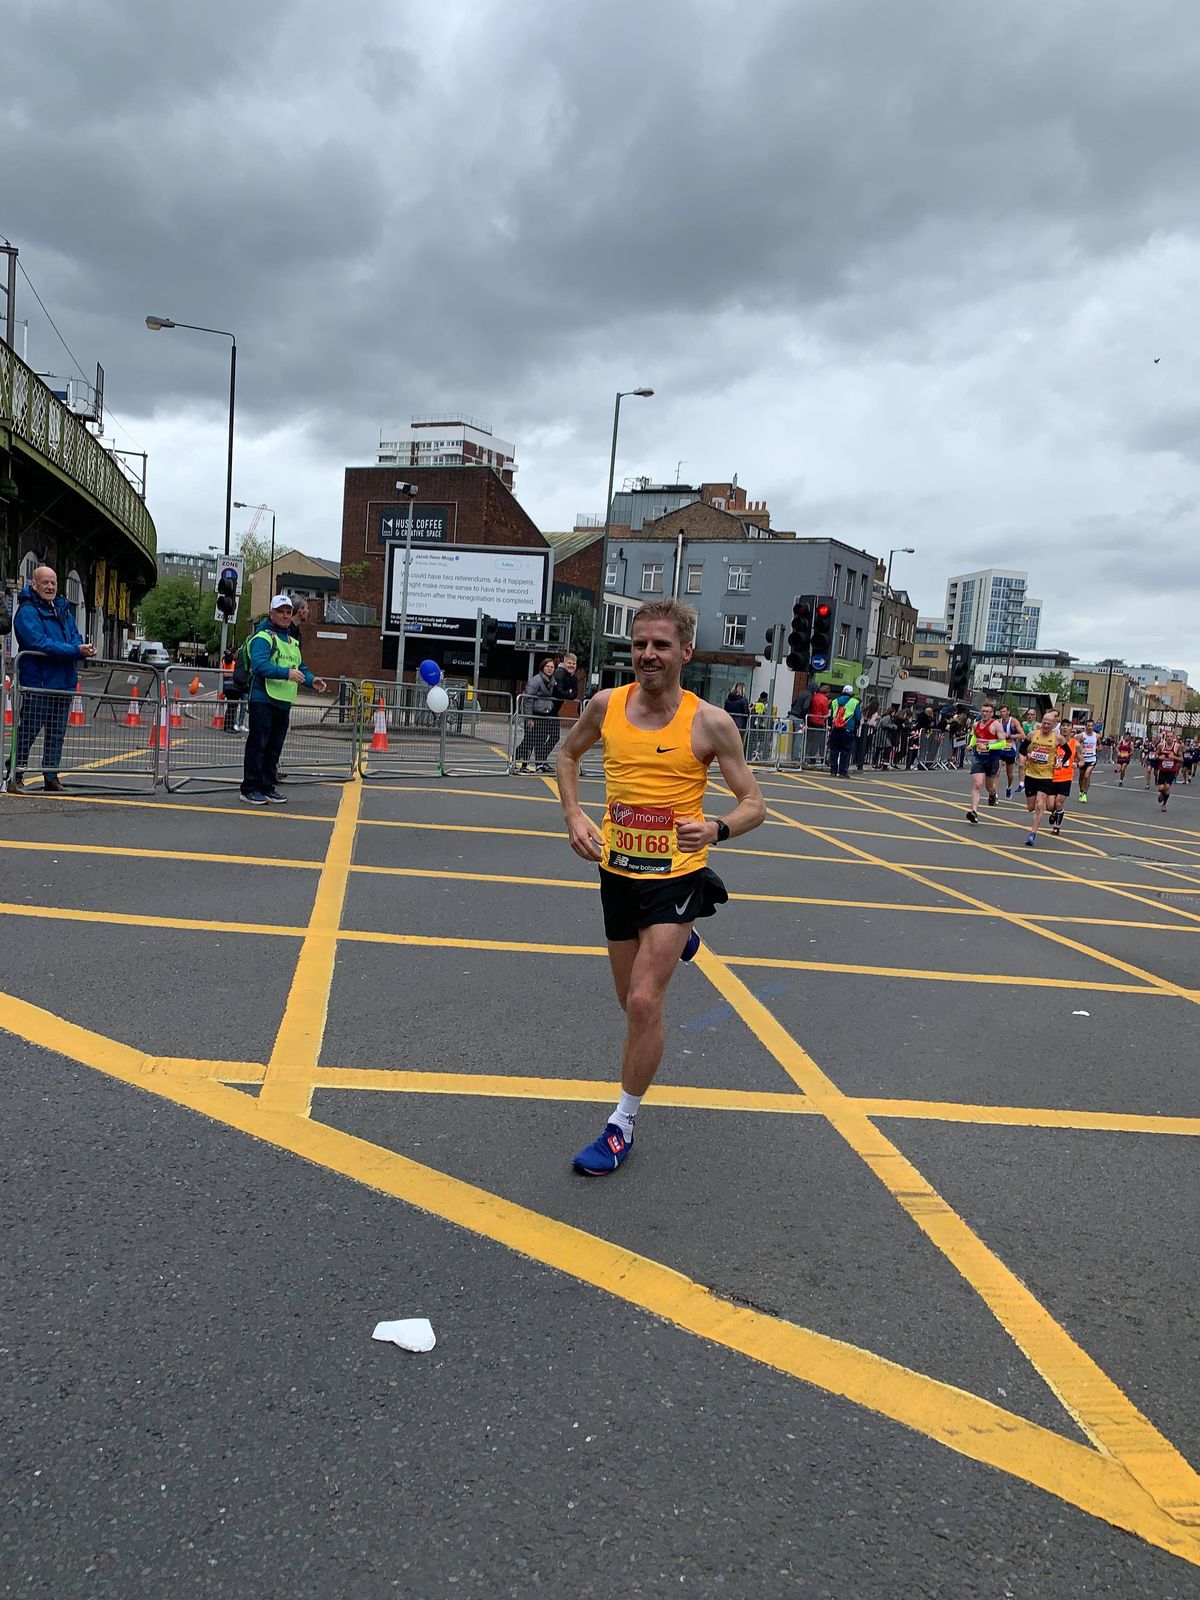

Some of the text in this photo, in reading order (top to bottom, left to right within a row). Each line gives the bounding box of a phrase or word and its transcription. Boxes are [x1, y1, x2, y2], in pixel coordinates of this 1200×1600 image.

[416, 519, 443, 529] COFFEE
[426, 530, 442, 538] SPACE
[454, 575, 491, 583] referendums.
[457, 594, 495, 602] renegotiation
[613, 803, 671, 825] Virgin money
[615, 830, 670, 854] 30168
